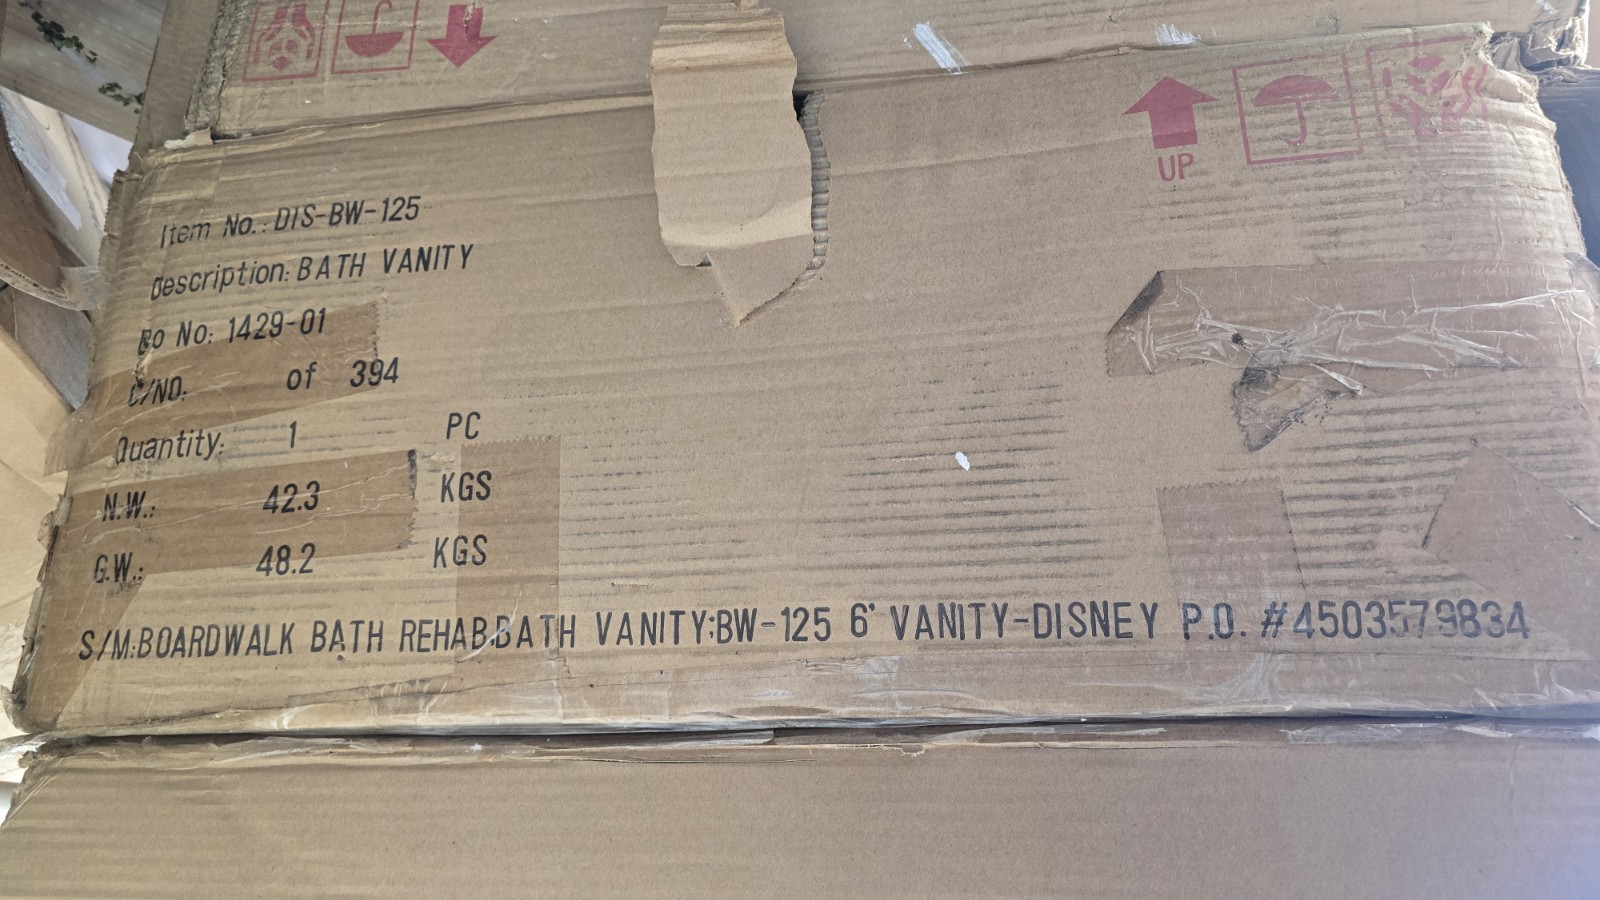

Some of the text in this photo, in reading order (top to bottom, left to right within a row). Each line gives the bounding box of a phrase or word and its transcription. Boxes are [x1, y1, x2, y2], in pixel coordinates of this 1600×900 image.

[1157, 152, 1195, 182] UP
[160, 223, 211, 249] Item
[383, 244, 474, 274] VANITY
[176, 319, 214, 347] No:
[228, 307, 326, 343] 1429-01
[286, 361, 317, 391] of
[350, 357, 400, 387] 394
[115, 412, 481, 465] Quantity: 1 PC
[102, 471, 493, 522] N.W.: 42.3 KGS
[93, 534, 488, 584] G.W.: 48.2 KGS
[311, 619, 384, 652] BATH
[890, 601, 1158, 641] VANITY-DISNEY
[1261, 598, 1530, 640] #4503579834
